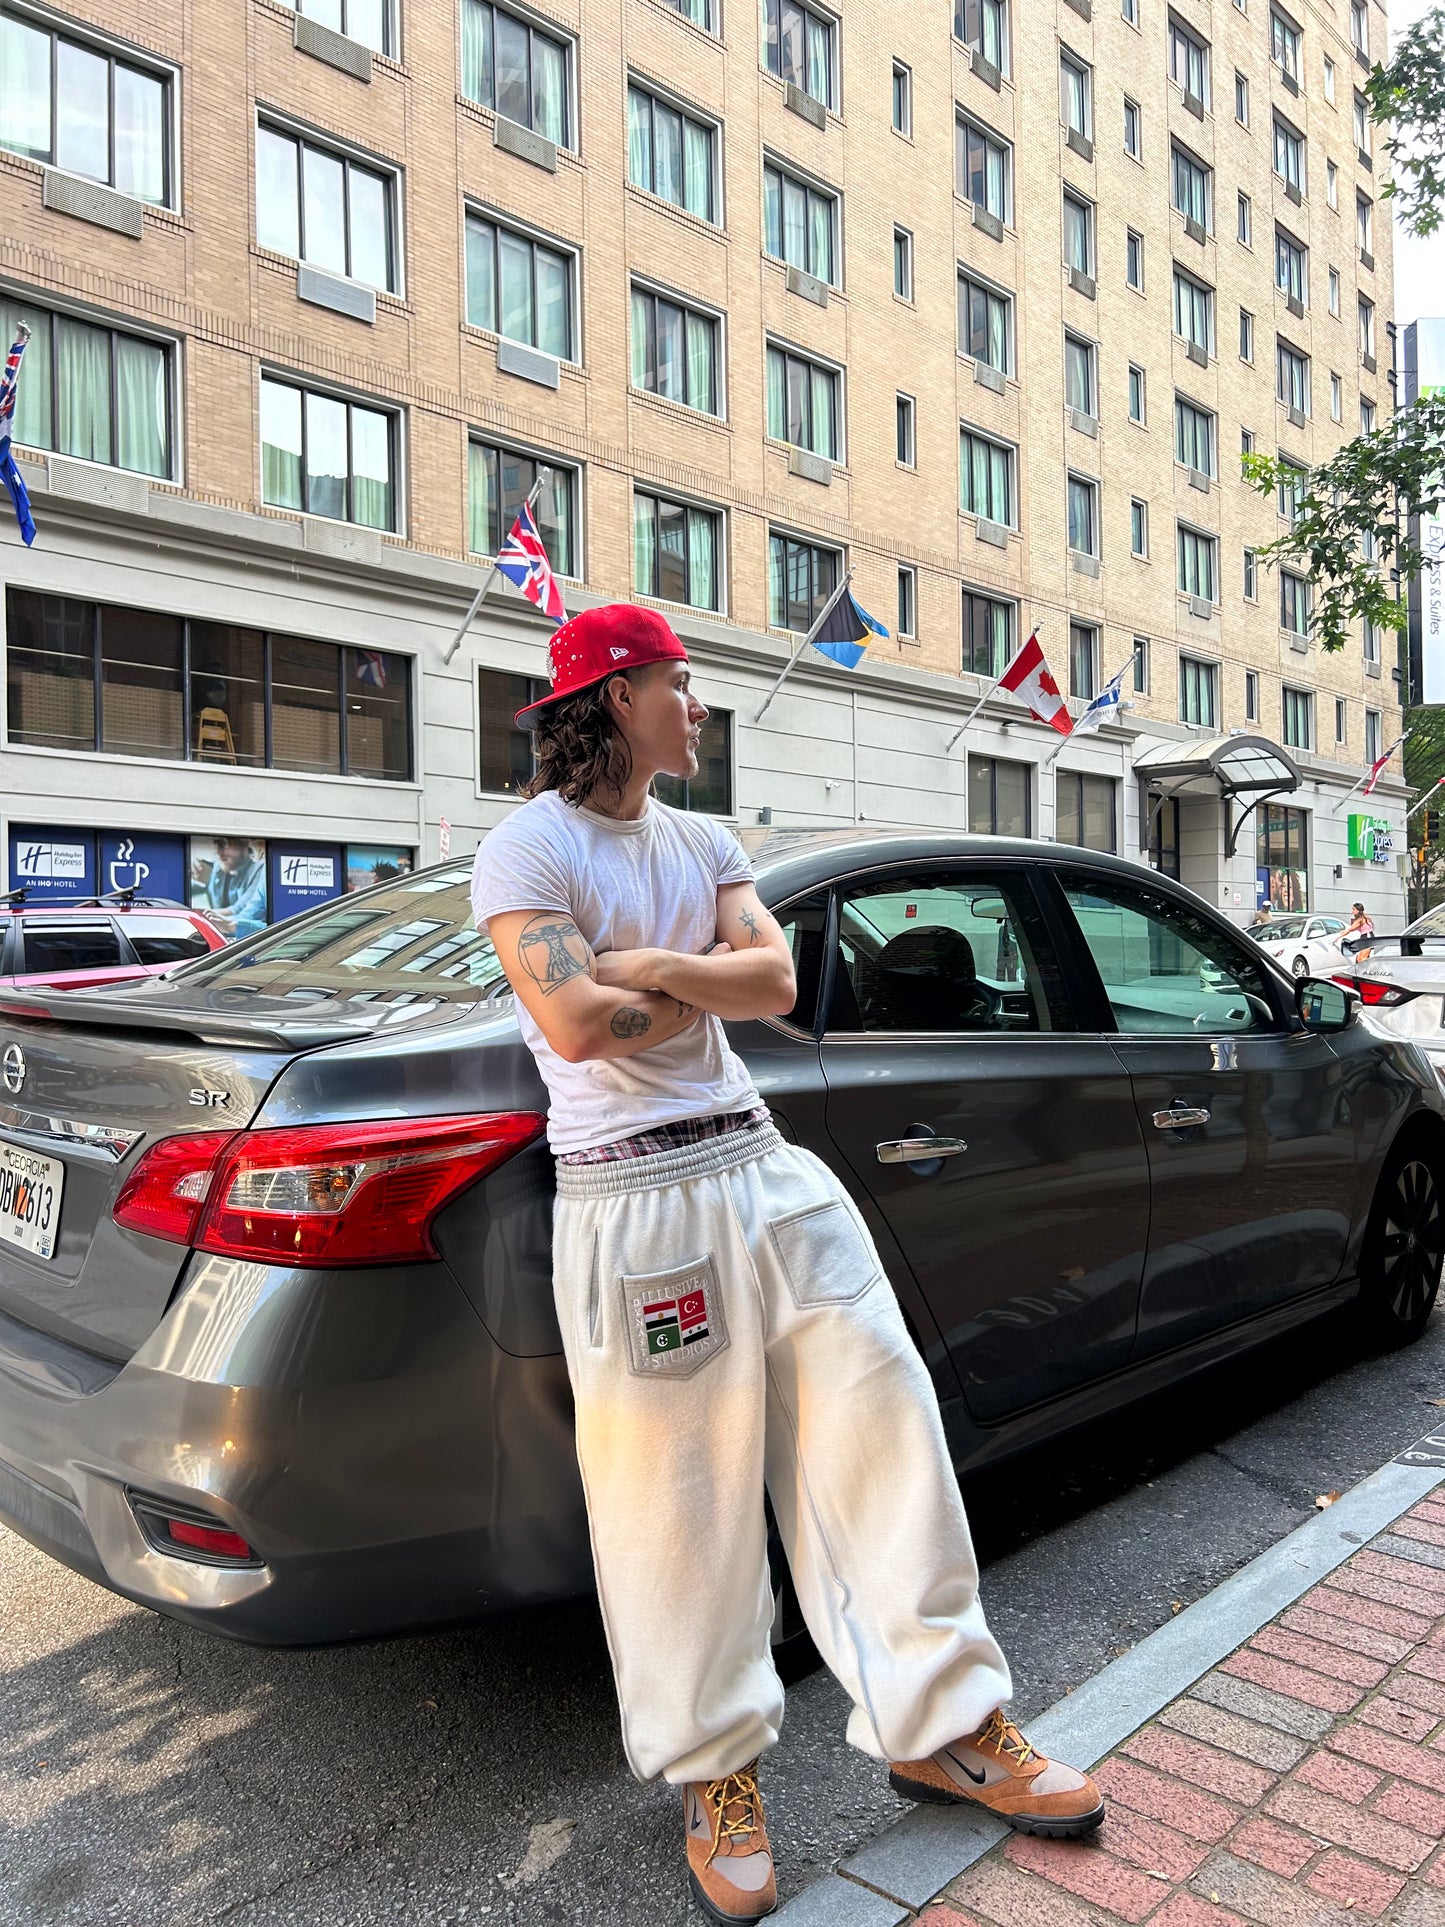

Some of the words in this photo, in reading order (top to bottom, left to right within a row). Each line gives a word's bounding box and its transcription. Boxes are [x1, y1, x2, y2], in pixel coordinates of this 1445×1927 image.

[1430, 587, 1441, 596] &
[1430, 599, 1442, 636] Suites
[54, 850, 73, 858] Holiday
[54, 857, 82, 867] Express
[309, 869, 332, 877] Express
[188, 1088, 230, 1108] SR
[8, 1151, 46, 1179] GEORGIA
[641, 1276, 700, 1304] ILLUSIVE
[651, 1340, 710, 1368] STUDIOS
